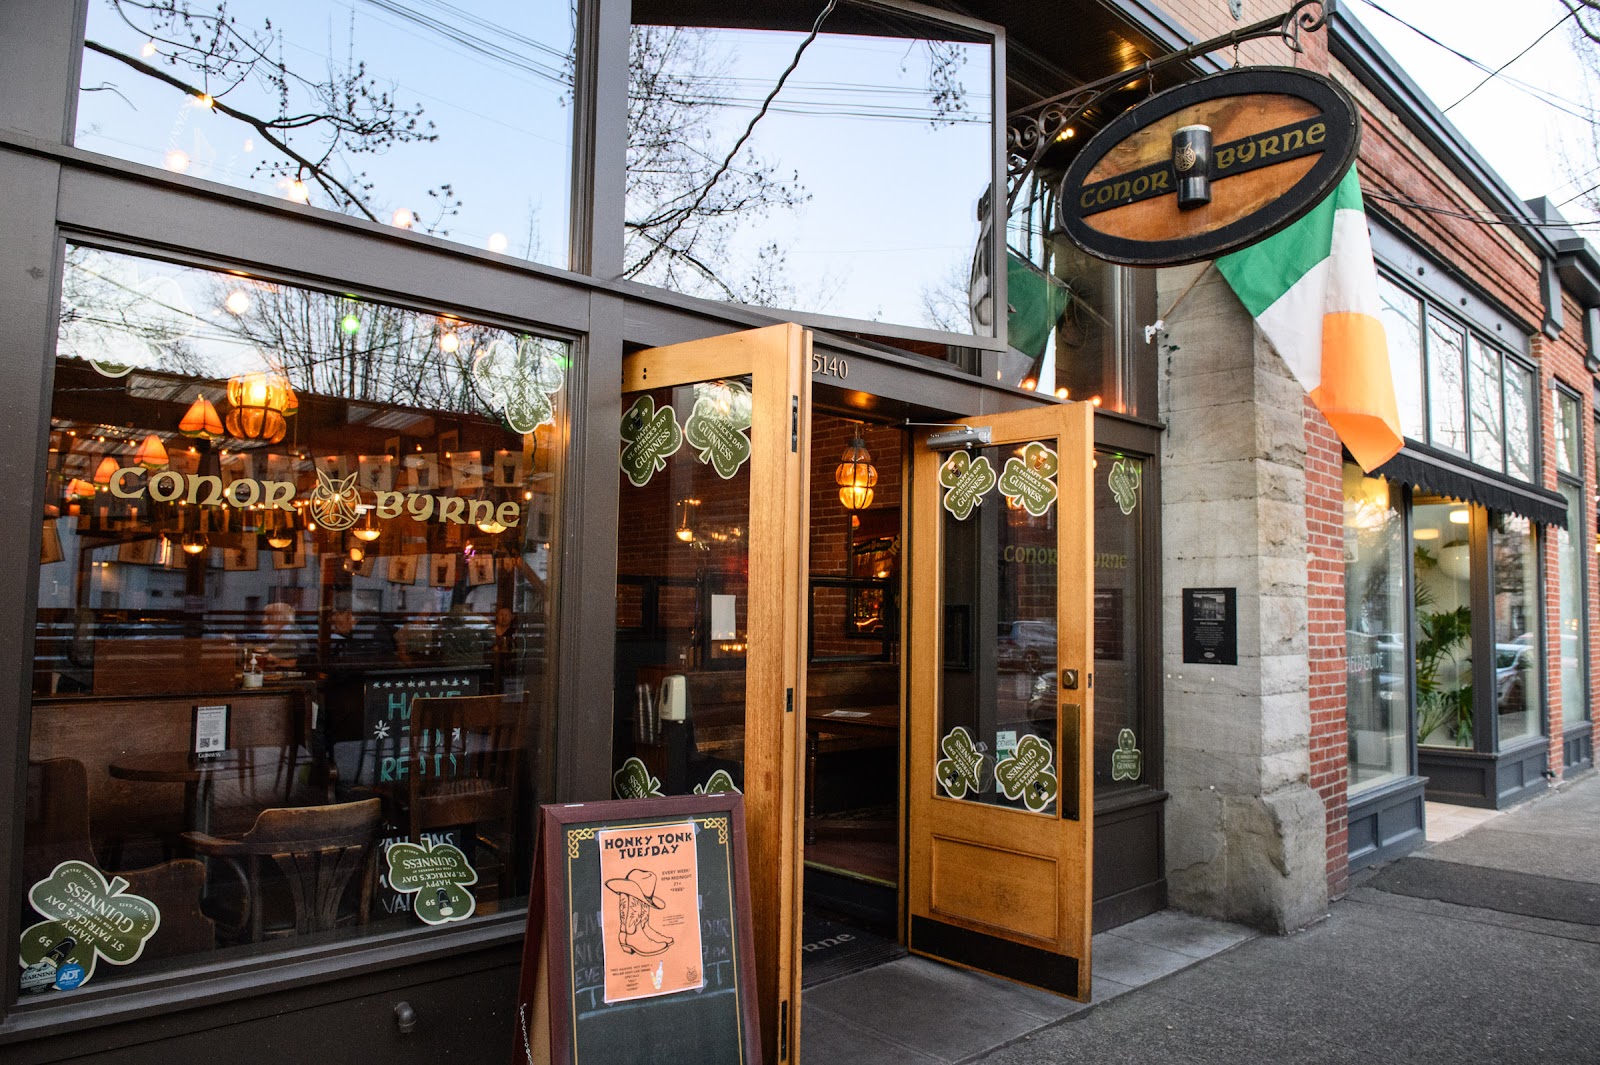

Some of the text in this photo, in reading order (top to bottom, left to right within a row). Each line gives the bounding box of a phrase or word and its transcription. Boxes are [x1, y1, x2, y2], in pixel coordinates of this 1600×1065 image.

[1081, 122, 1326, 208] CONOR BYRNE
[812, 354, 848, 379] 5140
[634, 426, 657, 453] PATRICK'S
[656, 415, 666, 427] DAY
[636, 423, 651, 440] HAPPY
[635, 428, 670, 469] GUINNESS
[699, 421, 733, 460] GUINNESS
[732, 438, 743, 450] DAY
[973, 464, 982, 474] DAY
[1027, 468, 1042, 480] HAPPY
[957, 471, 969, 487] HAPPY
[958, 474, 986, 507] GUINNESS
[1010, 475, 1043, 502] GUINNESS
[1041, 483, 1051, 493] DAY
[110, 467, 520, 528] CONOR BYRNE
[1006, 749, 1037, 781] GUINNESS
[1012, 783, 1020, 792] DAY
[605, 832, 692, 850] HONKY TONK
[619, 844, 678, 859] TUESDAY
[403, 857, 457, 869] GUINNESS
[402, 875, 418, 883] DAY
[420, 872, 456, 881] PATRICK'S
[425, 879, 451, 888] HAPPY
[64, 882, 134, 933] GUINNESS
[45, 895, 125, 951] ST. PATRICK'S DAY
[62, 920, 94, 944] HAPPY
[39, 936, 52, 947] 59
[59, 970, 80, 981] ADT
